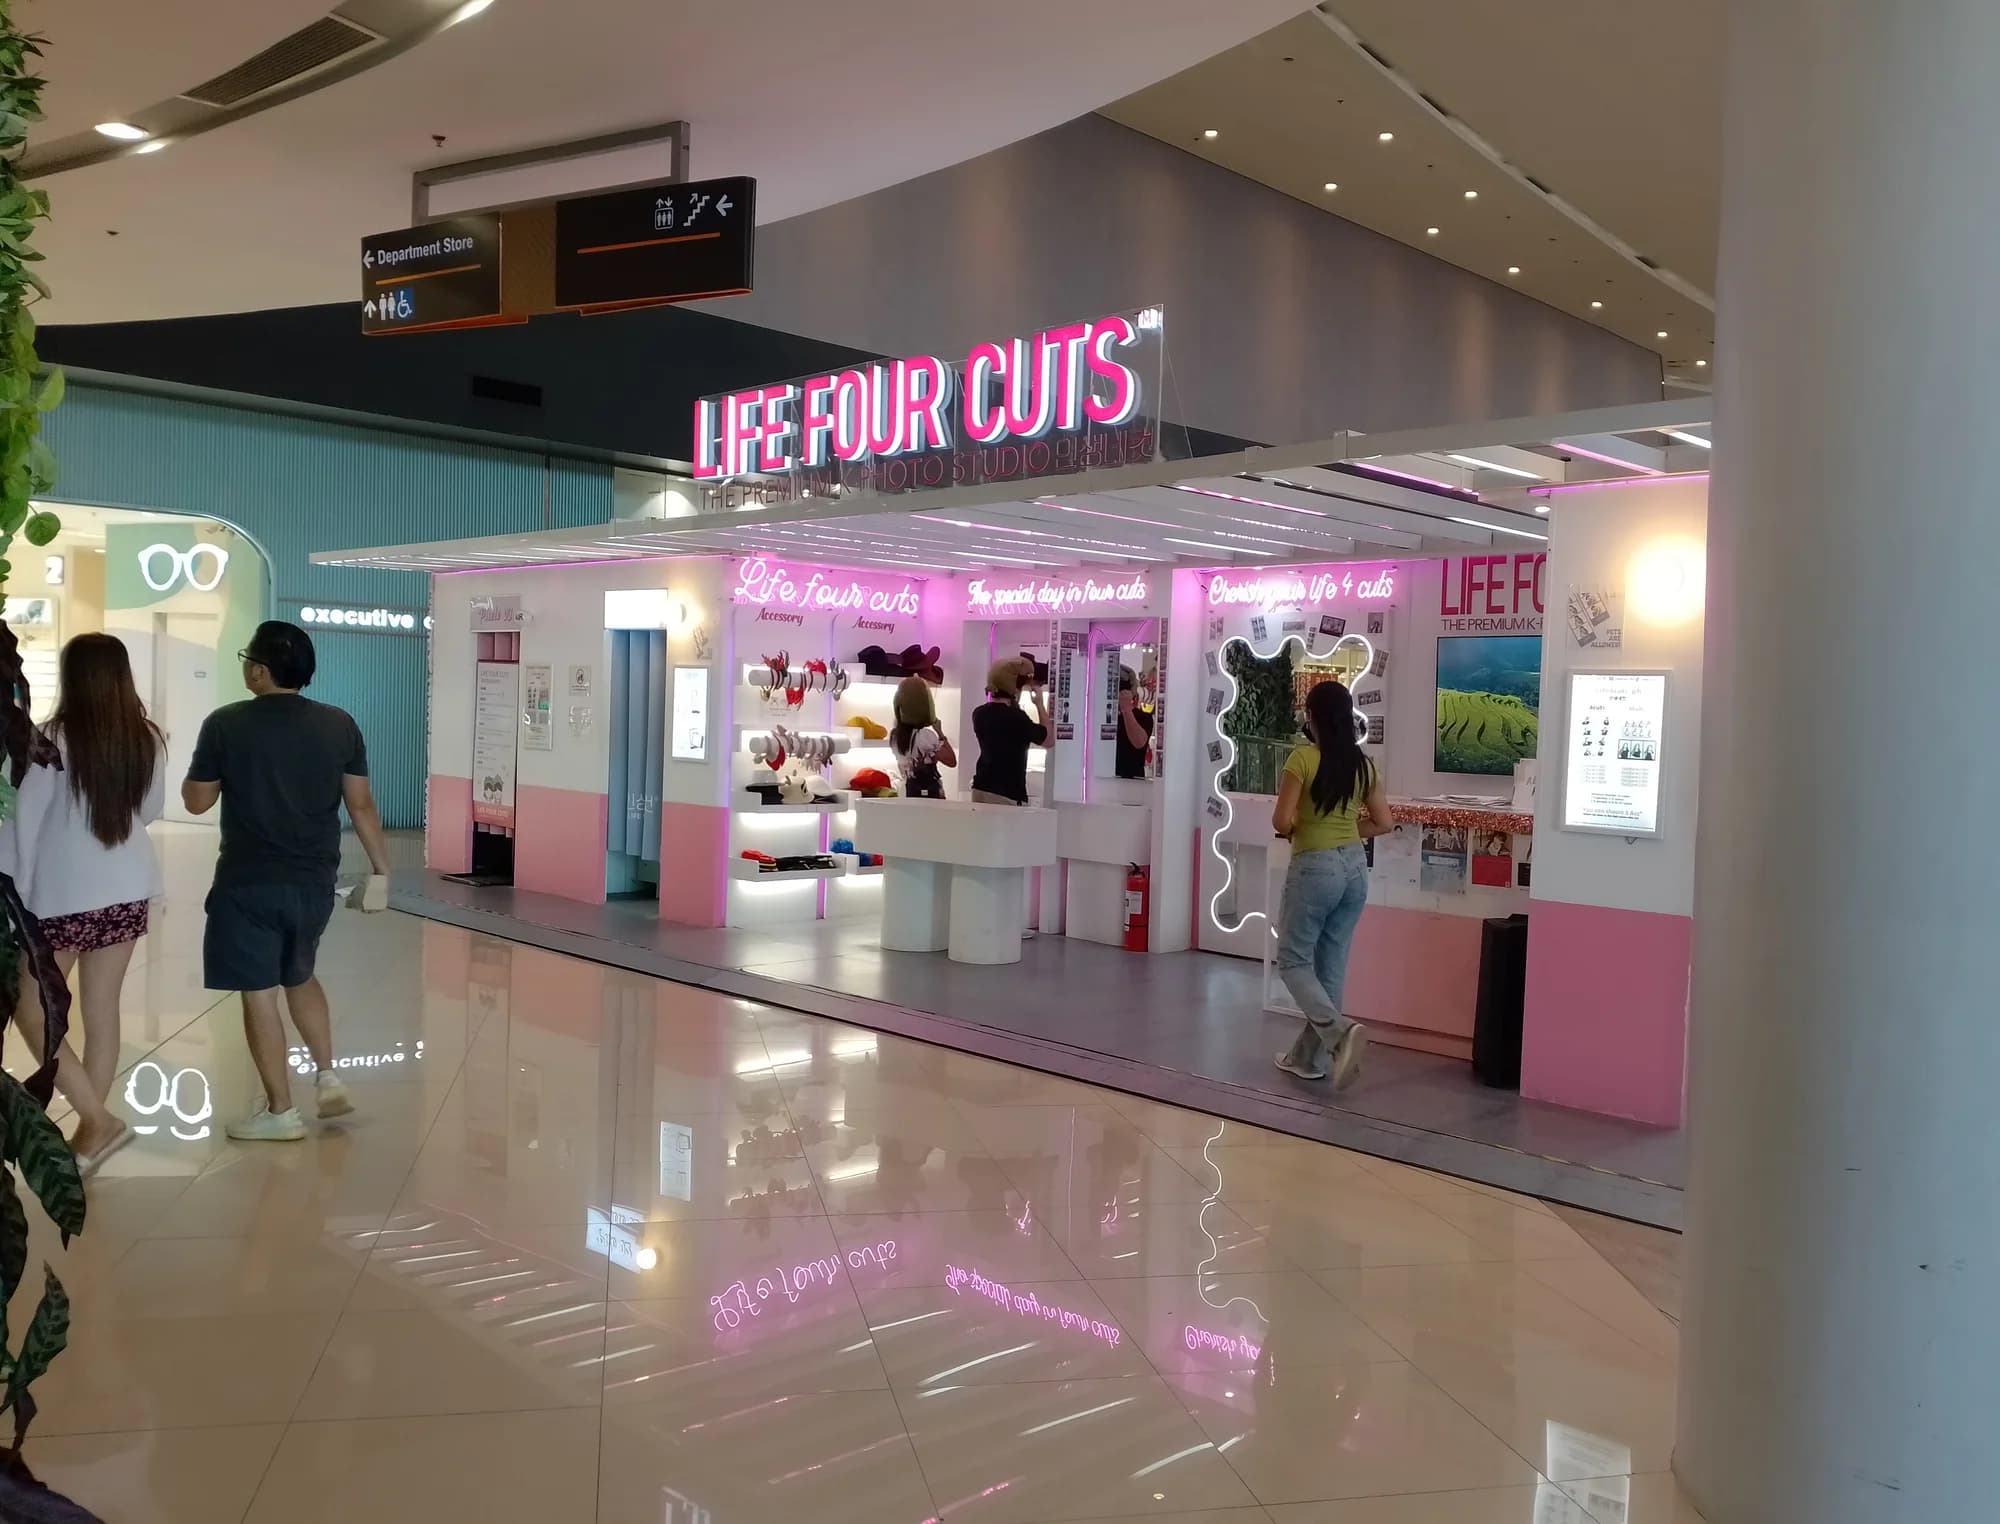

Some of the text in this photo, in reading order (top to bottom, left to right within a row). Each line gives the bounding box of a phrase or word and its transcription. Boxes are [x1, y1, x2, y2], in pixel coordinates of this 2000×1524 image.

[377, 237, 473, 266] Department Store
[693, 383, 796, 480] LIFE
[802, 355, 946, 464] FOUR
[963, 315, 1137, 442] CUTS
[699, 484, 736, 510] THE
[953, 440, 1050, 483] STUDIO
[734, 556, 919, 615] Life four cuts
[968, 578, 992, 605] The
[994, 580, 1035, 608] special
[1037, 580, 1065, 610] day
[1082, 578, 1114, 605] four
[1116, 575, 1146, 601] cuts
[1342, 571, 1353, 597] 4
[1357, 569, 1394, 599] cuts
[1440, 554, 1507, 616] LIFE
[300, 606, 414, 629] executive
[755, 607, 804, 627] Accessory
[852, 615, 895, 634] Accessory
[1441, 618, 1465, 631] THE
[1467, 617, 1526, 631] PREMIUM
